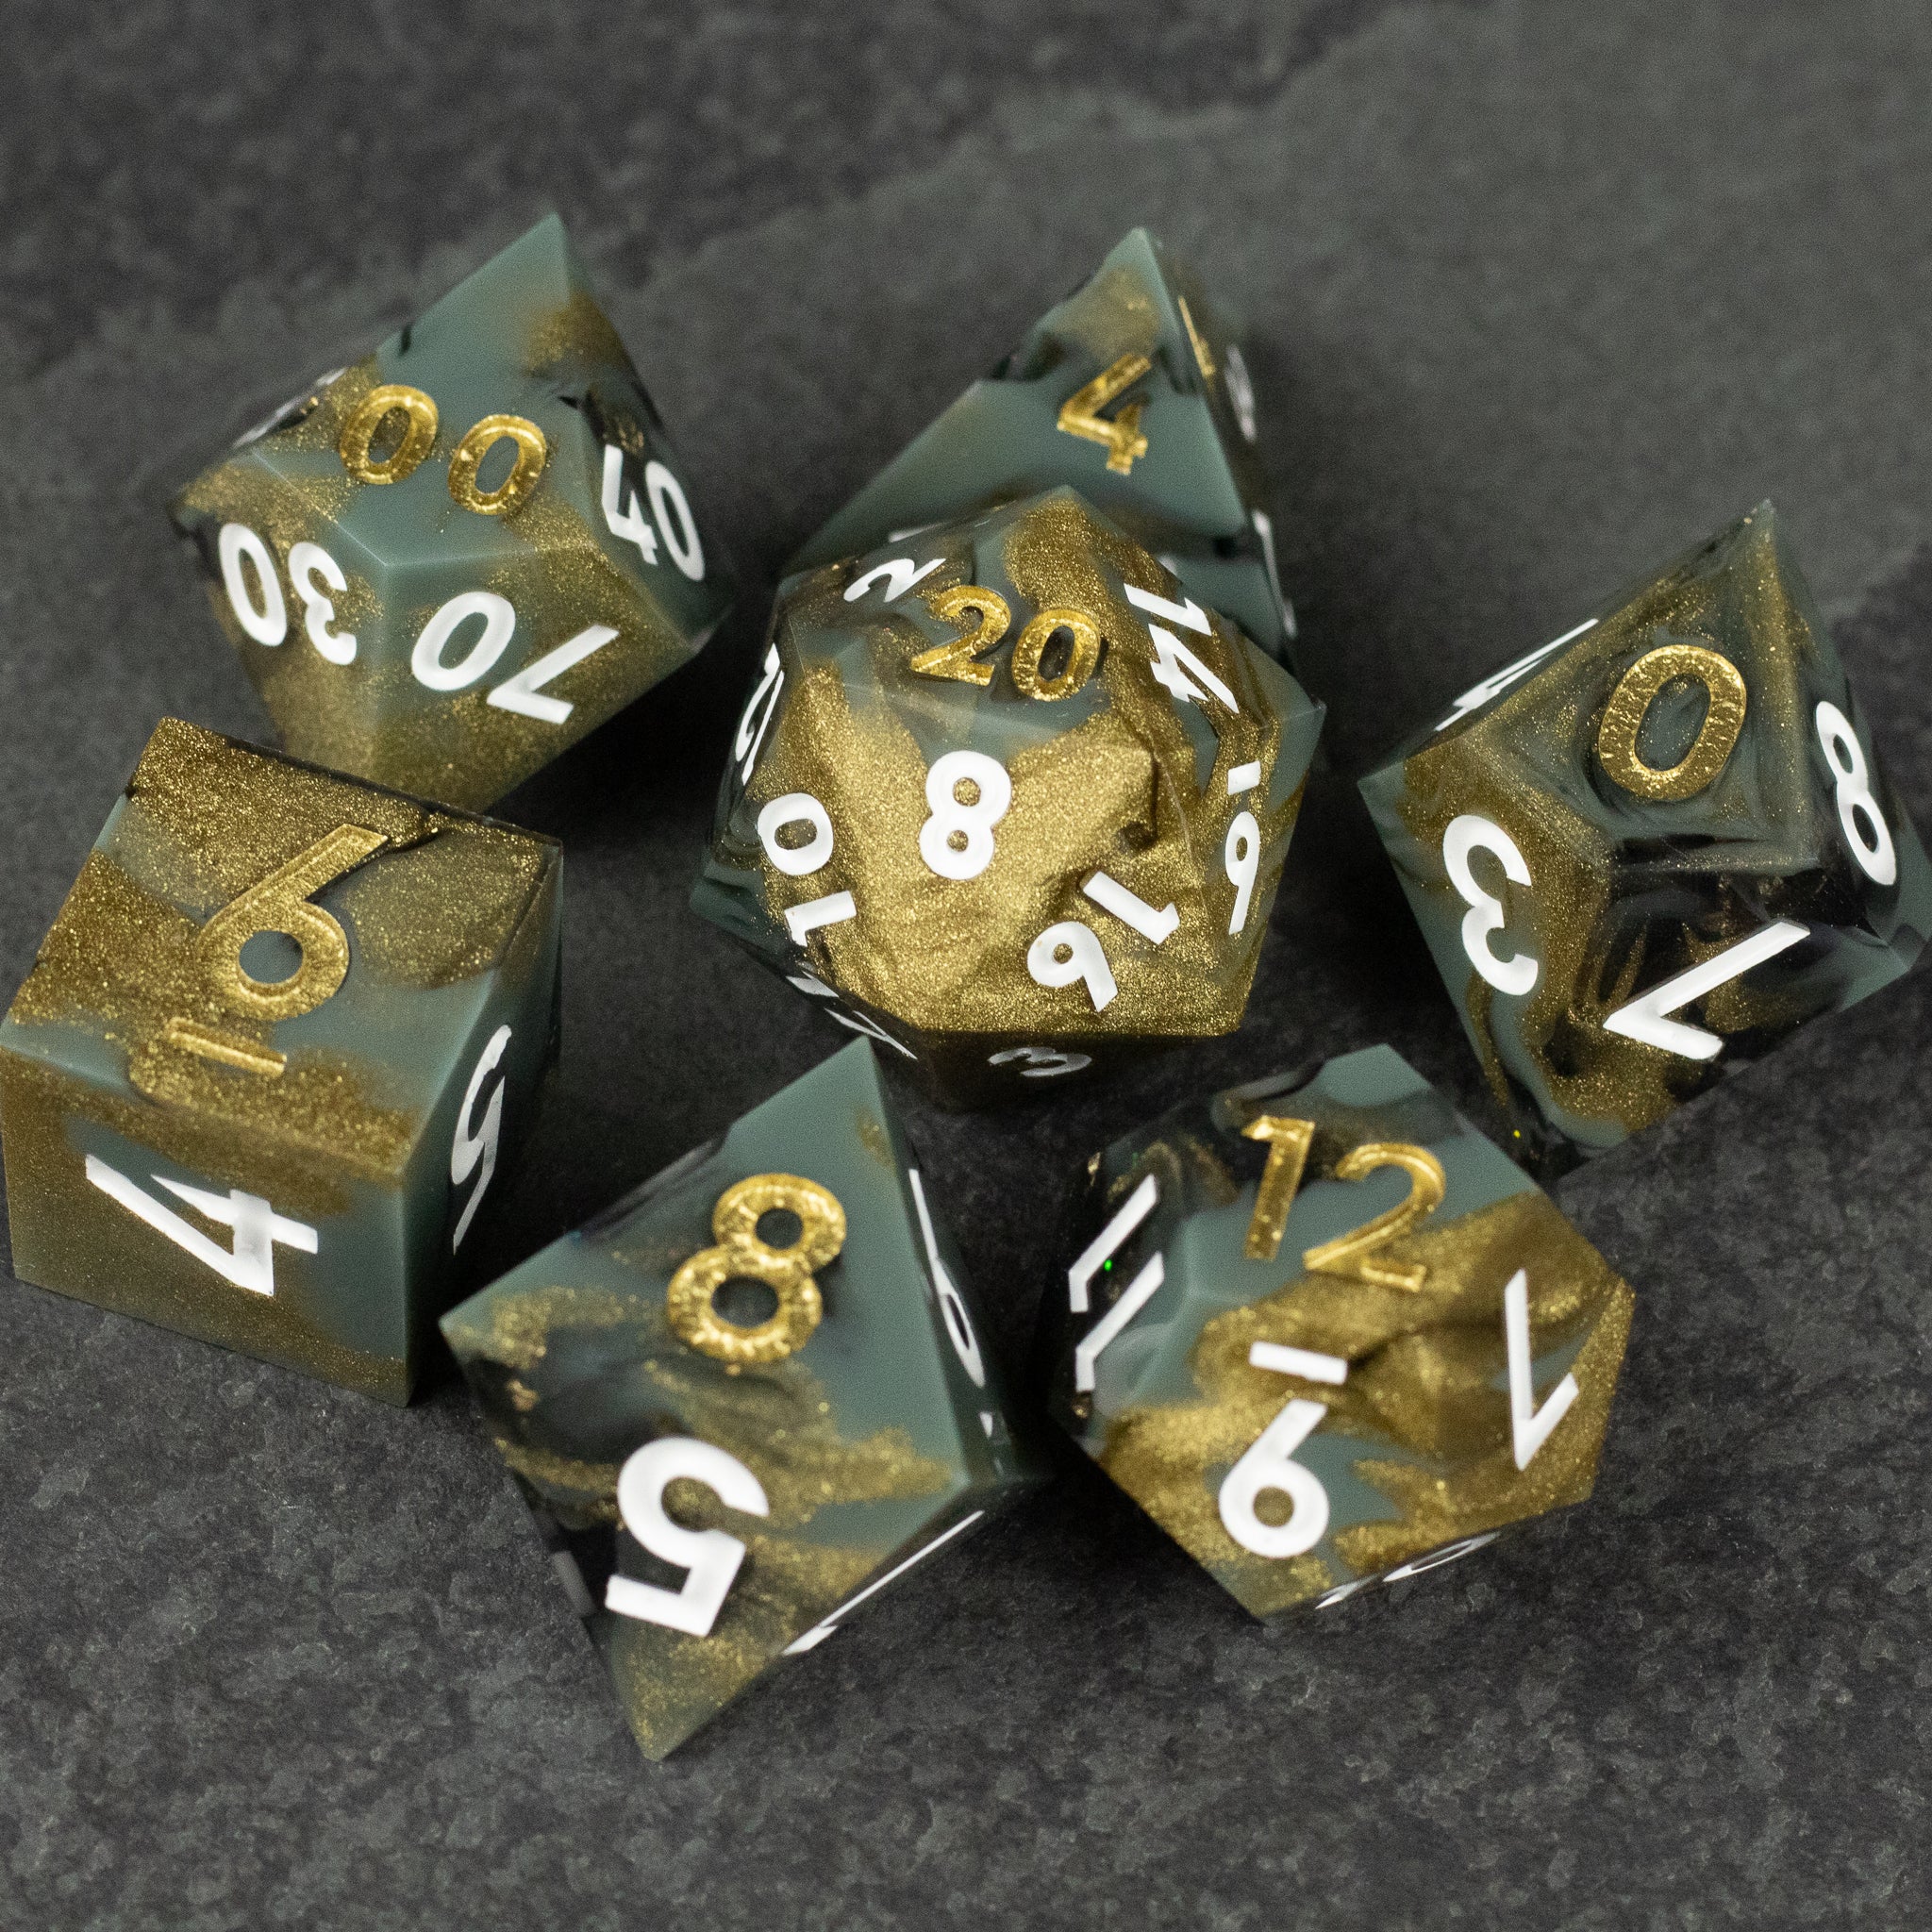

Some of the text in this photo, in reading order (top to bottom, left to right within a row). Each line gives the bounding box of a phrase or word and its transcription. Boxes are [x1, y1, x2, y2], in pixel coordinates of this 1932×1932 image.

[341, 384, 546, 515] 00
[1057, 354, 1151, 475] 4
[601, 445, 704, 580] 40
[843, 558, 947, 602] 2
[218, 523, 358, 665] 30
[410, 591, 619, 724] 70
[909, 585, 1101, 701] 20
[1124, 583, 1239, 714] 14
[1599, 644, 1747, 801] 0
[1816, 701, 1897, 886] 8
[756, 792, 858, 947] 10
[918, 750, 1012, 881] 8
[194, 824, 388, 1021] 6
[1026, 871, 1180, 1013] 16
[1443, 815, 1539, 996] 3
[987, 1046, 1092, 1077] 3
[1603, 921, 1811, 1060] 7
[85, 1154, 319, 1297] 4
[667, 1173, 847, 1363] 8
[1241, 1115, 1446, 1292] 12
[1069, 1174, 1165, 1391] 11
[1504, 1269, 1579, 1472] 7
[605, 1437, 770, 1638] 5
